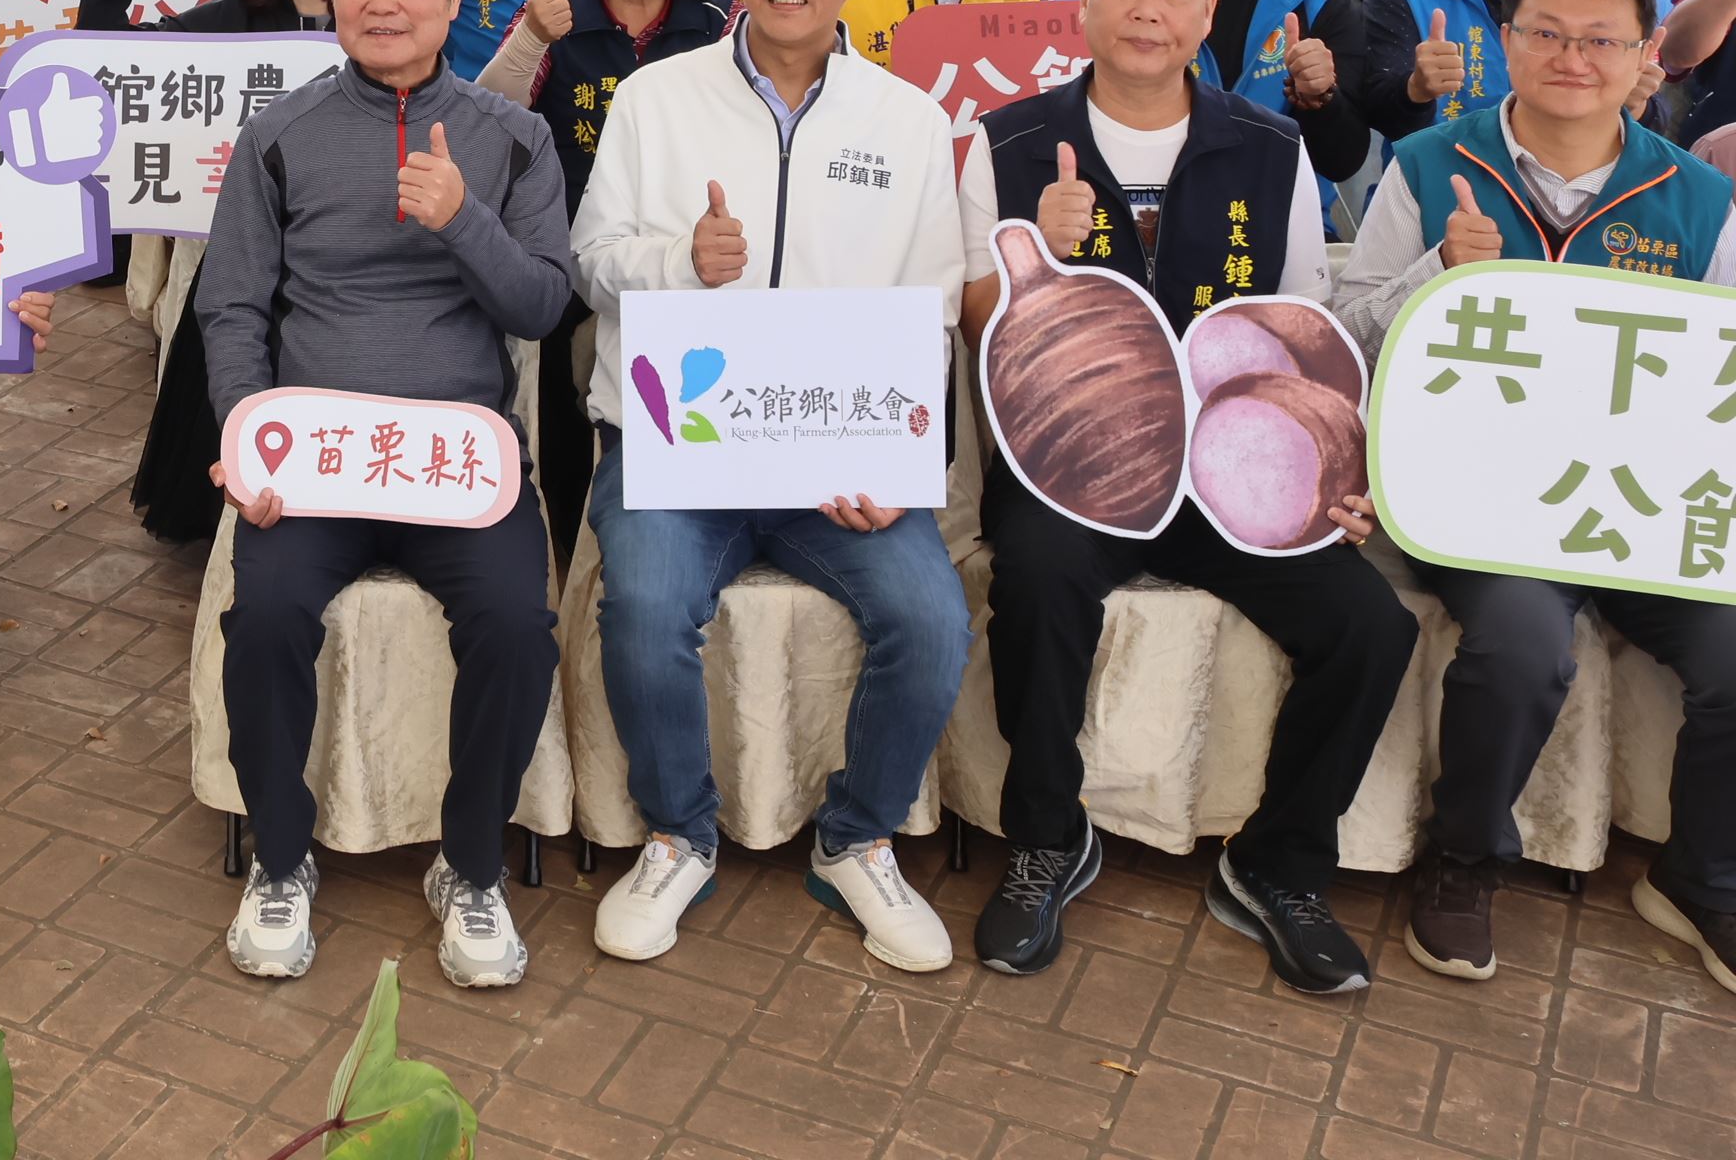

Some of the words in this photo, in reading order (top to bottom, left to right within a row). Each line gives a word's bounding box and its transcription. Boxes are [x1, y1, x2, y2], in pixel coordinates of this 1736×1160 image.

[979, 14, 1082, 39] Miaol
[1468, 25, 1486, 98] 館東村長
[93, 63, 341, 128] 館鄉農
[826, 161, 892, 190] 邱鎮軍
[840, 148, 886, 166] 立法委員
[1091, 208, 1115, 259] 主席
[1227, 200, 1251, 248] 縣長
[1636, 237, 1679, 260] 苗栗區
[730, 426, 790, 442] Kung-Kuan
[309, 422, 498, 490] 苗栗縣
